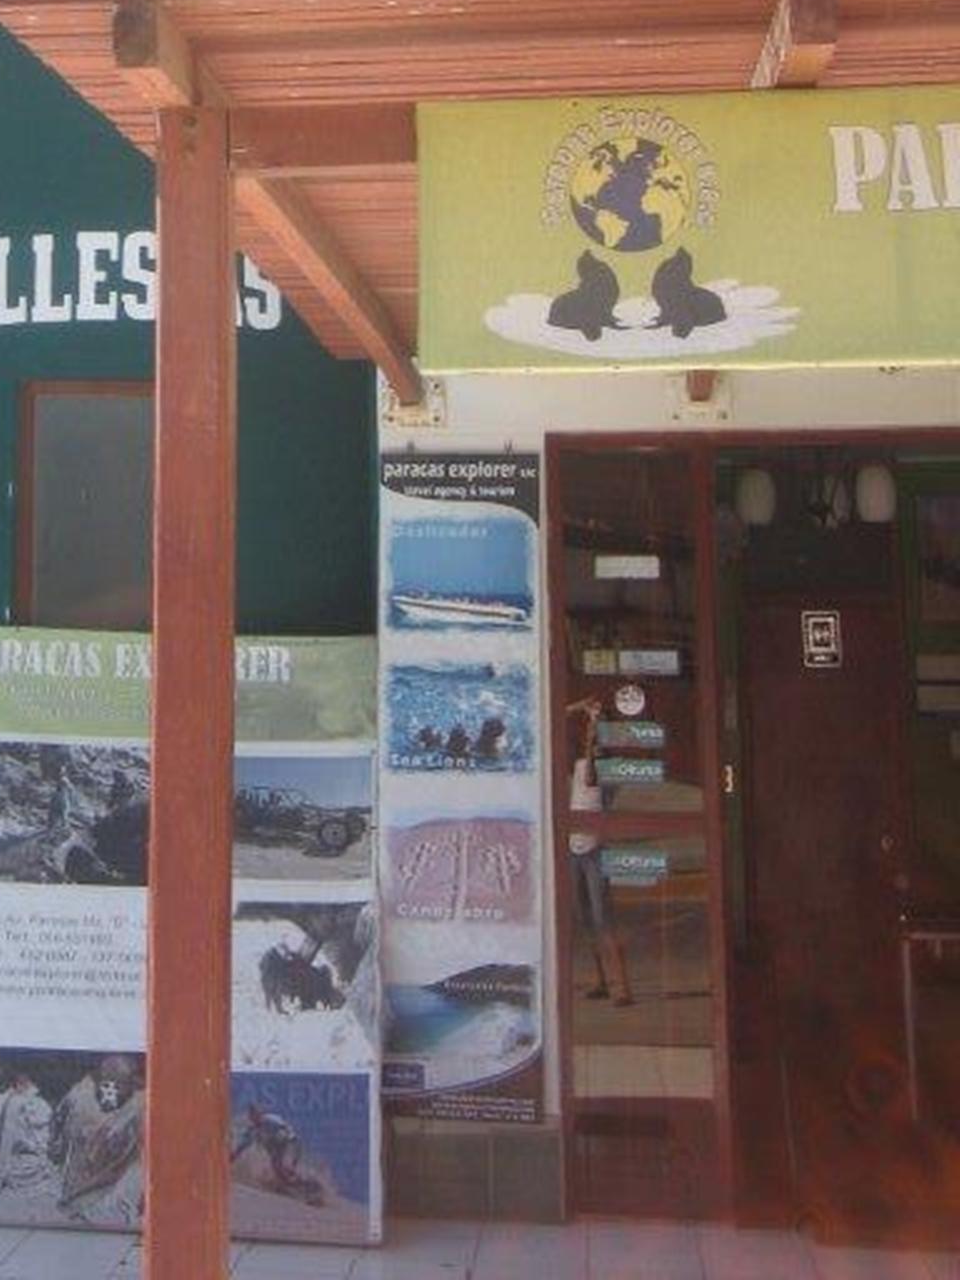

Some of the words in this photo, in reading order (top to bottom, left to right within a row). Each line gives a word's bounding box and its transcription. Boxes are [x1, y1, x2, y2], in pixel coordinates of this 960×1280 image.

[383, 462, 445, 482] paracas
[448, 460, 517, 482] explorer
[114, 643, 292, 682] EXRER
